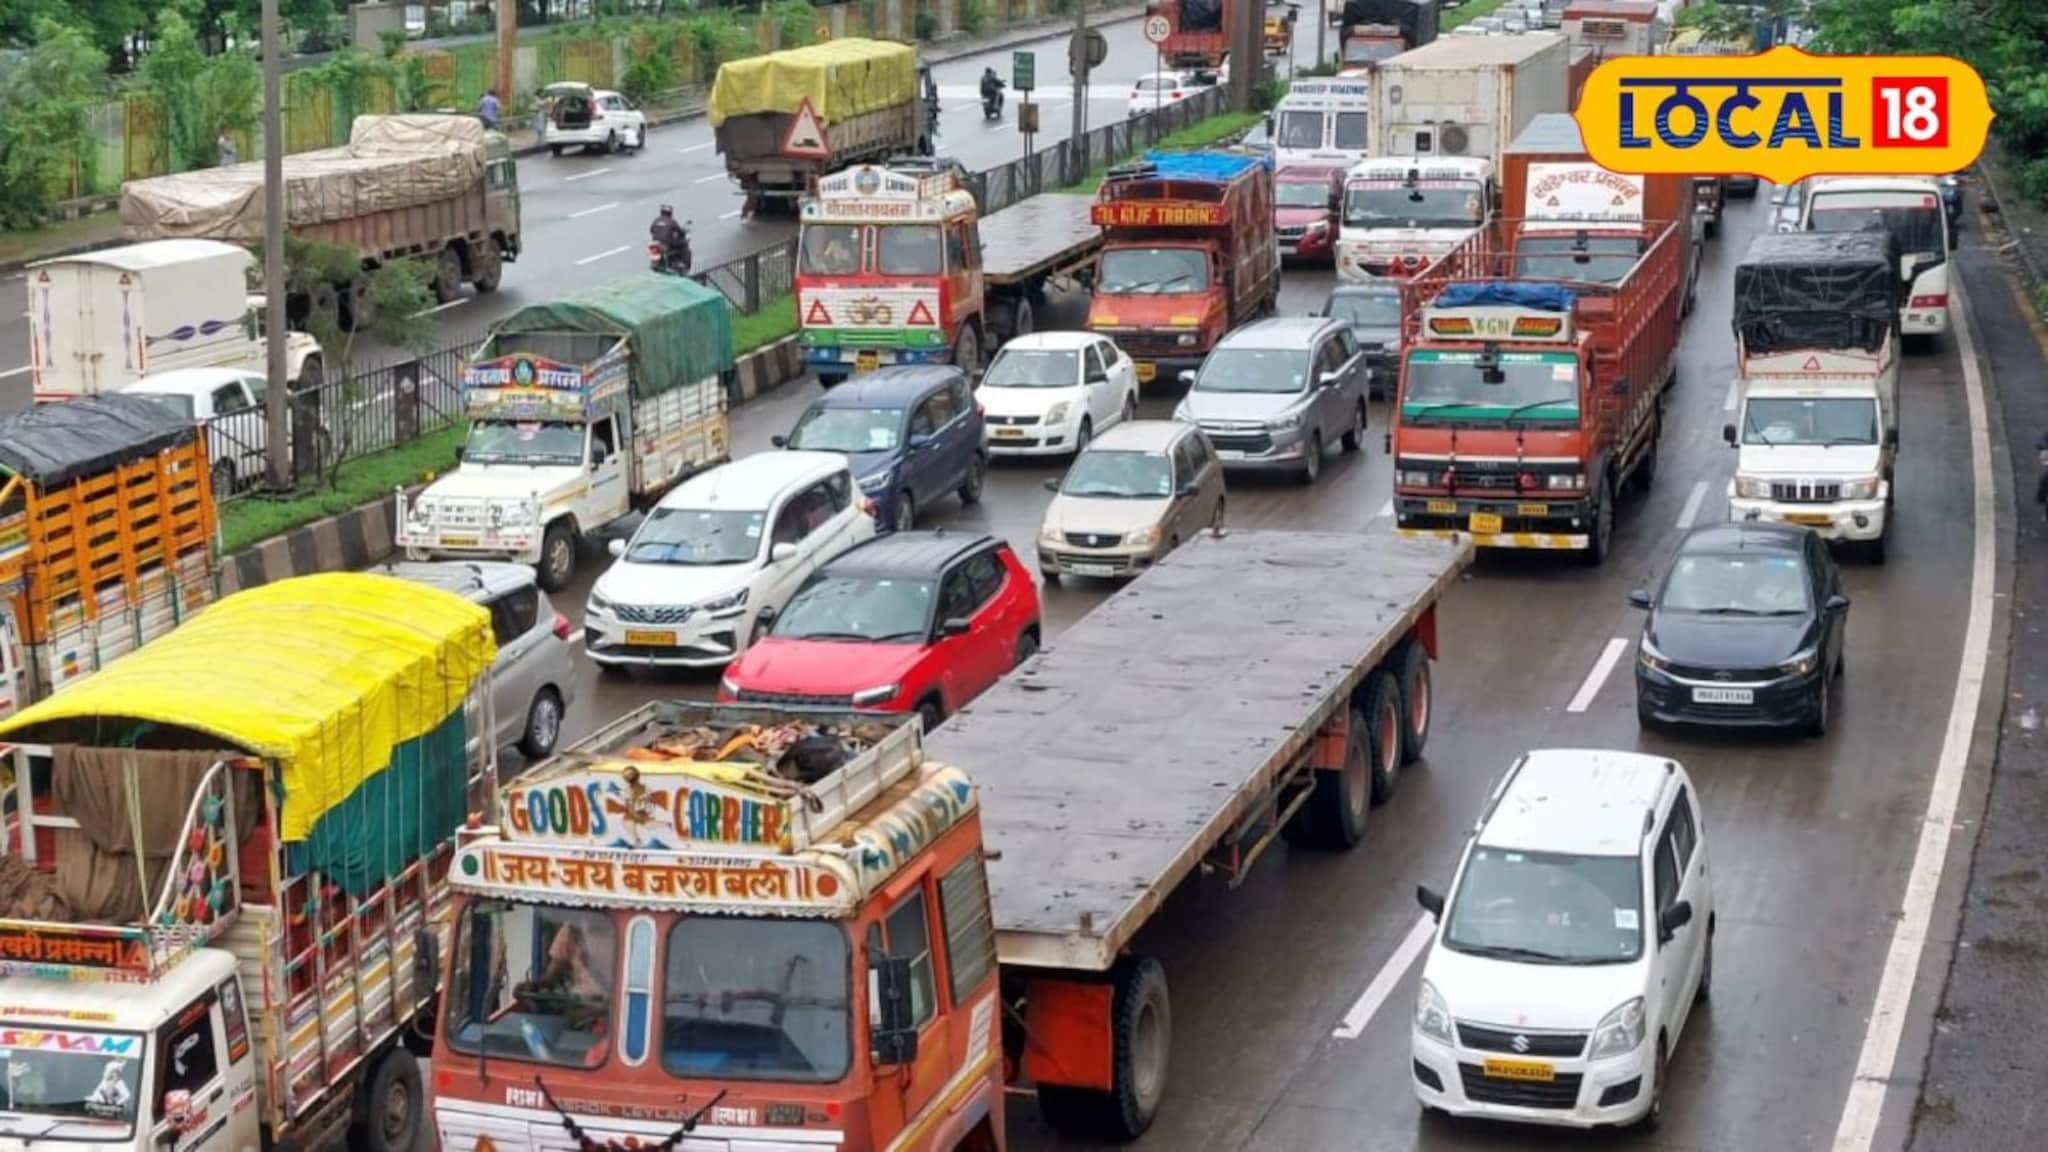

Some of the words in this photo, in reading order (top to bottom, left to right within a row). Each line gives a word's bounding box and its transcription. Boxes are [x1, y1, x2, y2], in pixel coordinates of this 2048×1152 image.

[1150, 22, 1168, 35] 30
[508, 782, 606, 836] GOODS
[673, 787, 783, 846] CARRIER
